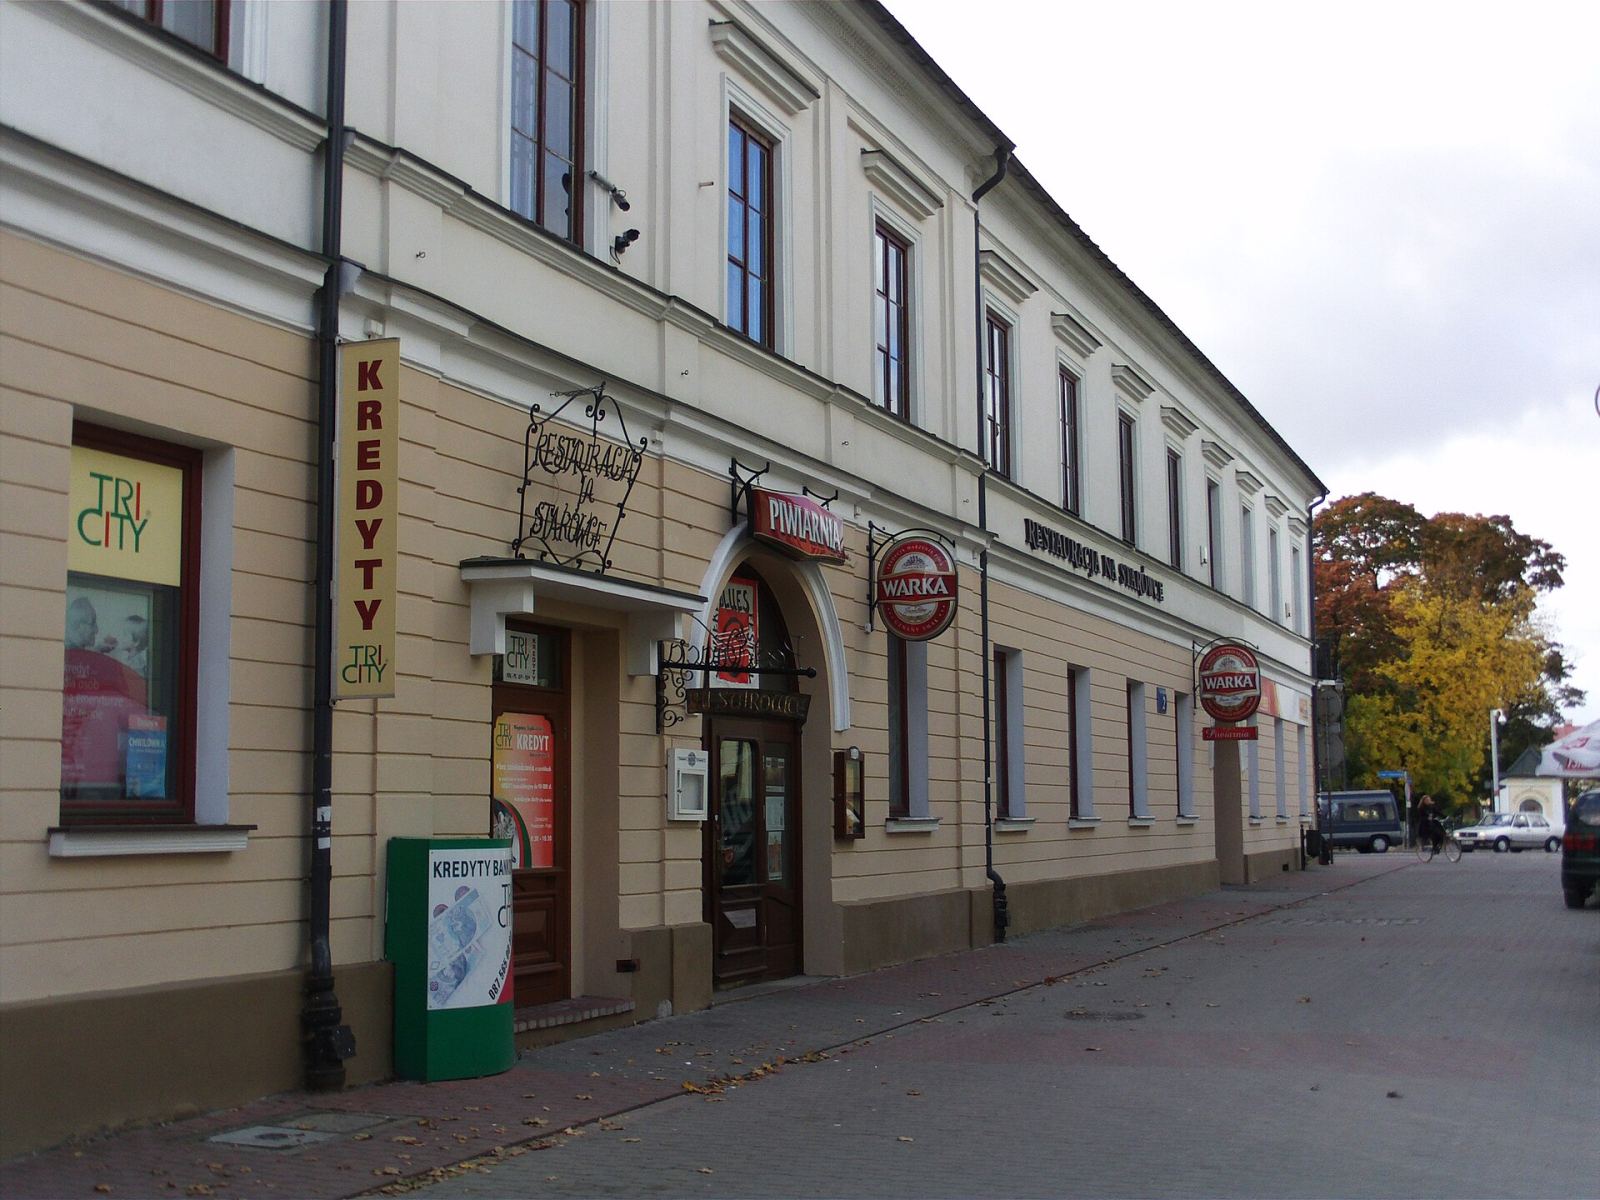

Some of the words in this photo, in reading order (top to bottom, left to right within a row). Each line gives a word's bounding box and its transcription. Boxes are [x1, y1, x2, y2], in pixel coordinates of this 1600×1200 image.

[90, 472, 140, 520] TRI
[354, 360, 383, 630] KREDYTY
[77, 508, 148, 552] CITY
[768, 496, 842, 552] PIWIARNIA
[882, 577, 949, 597] WARKA
[349, 644, 382, 665] TRI
[510, 635, 528, 655] TRI
[506, 650, 530, 670] CITY
[342, 663, 387, 683] CITY
[1204, 675, 1254, 690] WARKA
[498, 723, 511, 737] TRI
[495, 734, 512, 747] CITY
[516, 733, 550, 751] KREDYT
[433, 860, 491, 878] KREDYTY
